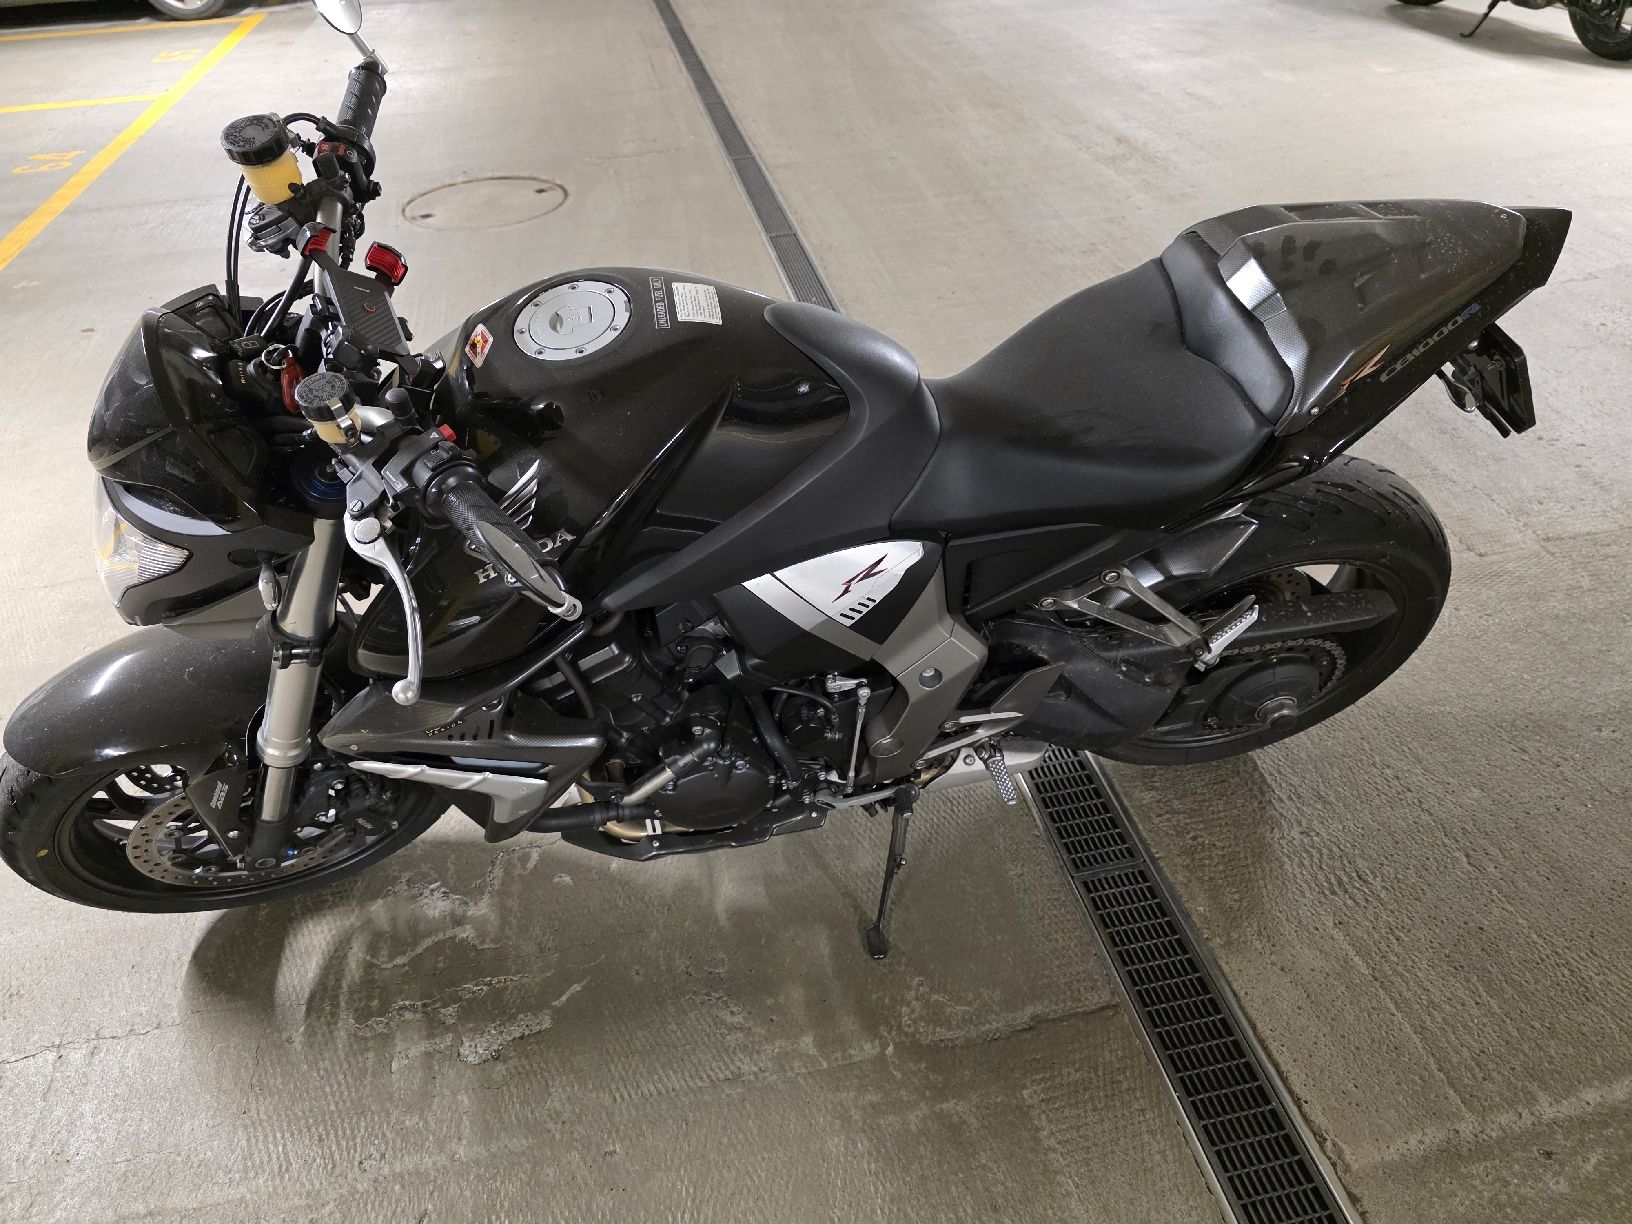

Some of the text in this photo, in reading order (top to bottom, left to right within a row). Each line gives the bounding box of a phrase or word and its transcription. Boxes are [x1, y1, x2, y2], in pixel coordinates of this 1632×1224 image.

[654, 289, 664, 301] FUEL
[655, 302, 668, 327] UNLEADED
[1379, 303, 1481, 383] CB1000R
[474, 528, 577, 584] HDA
